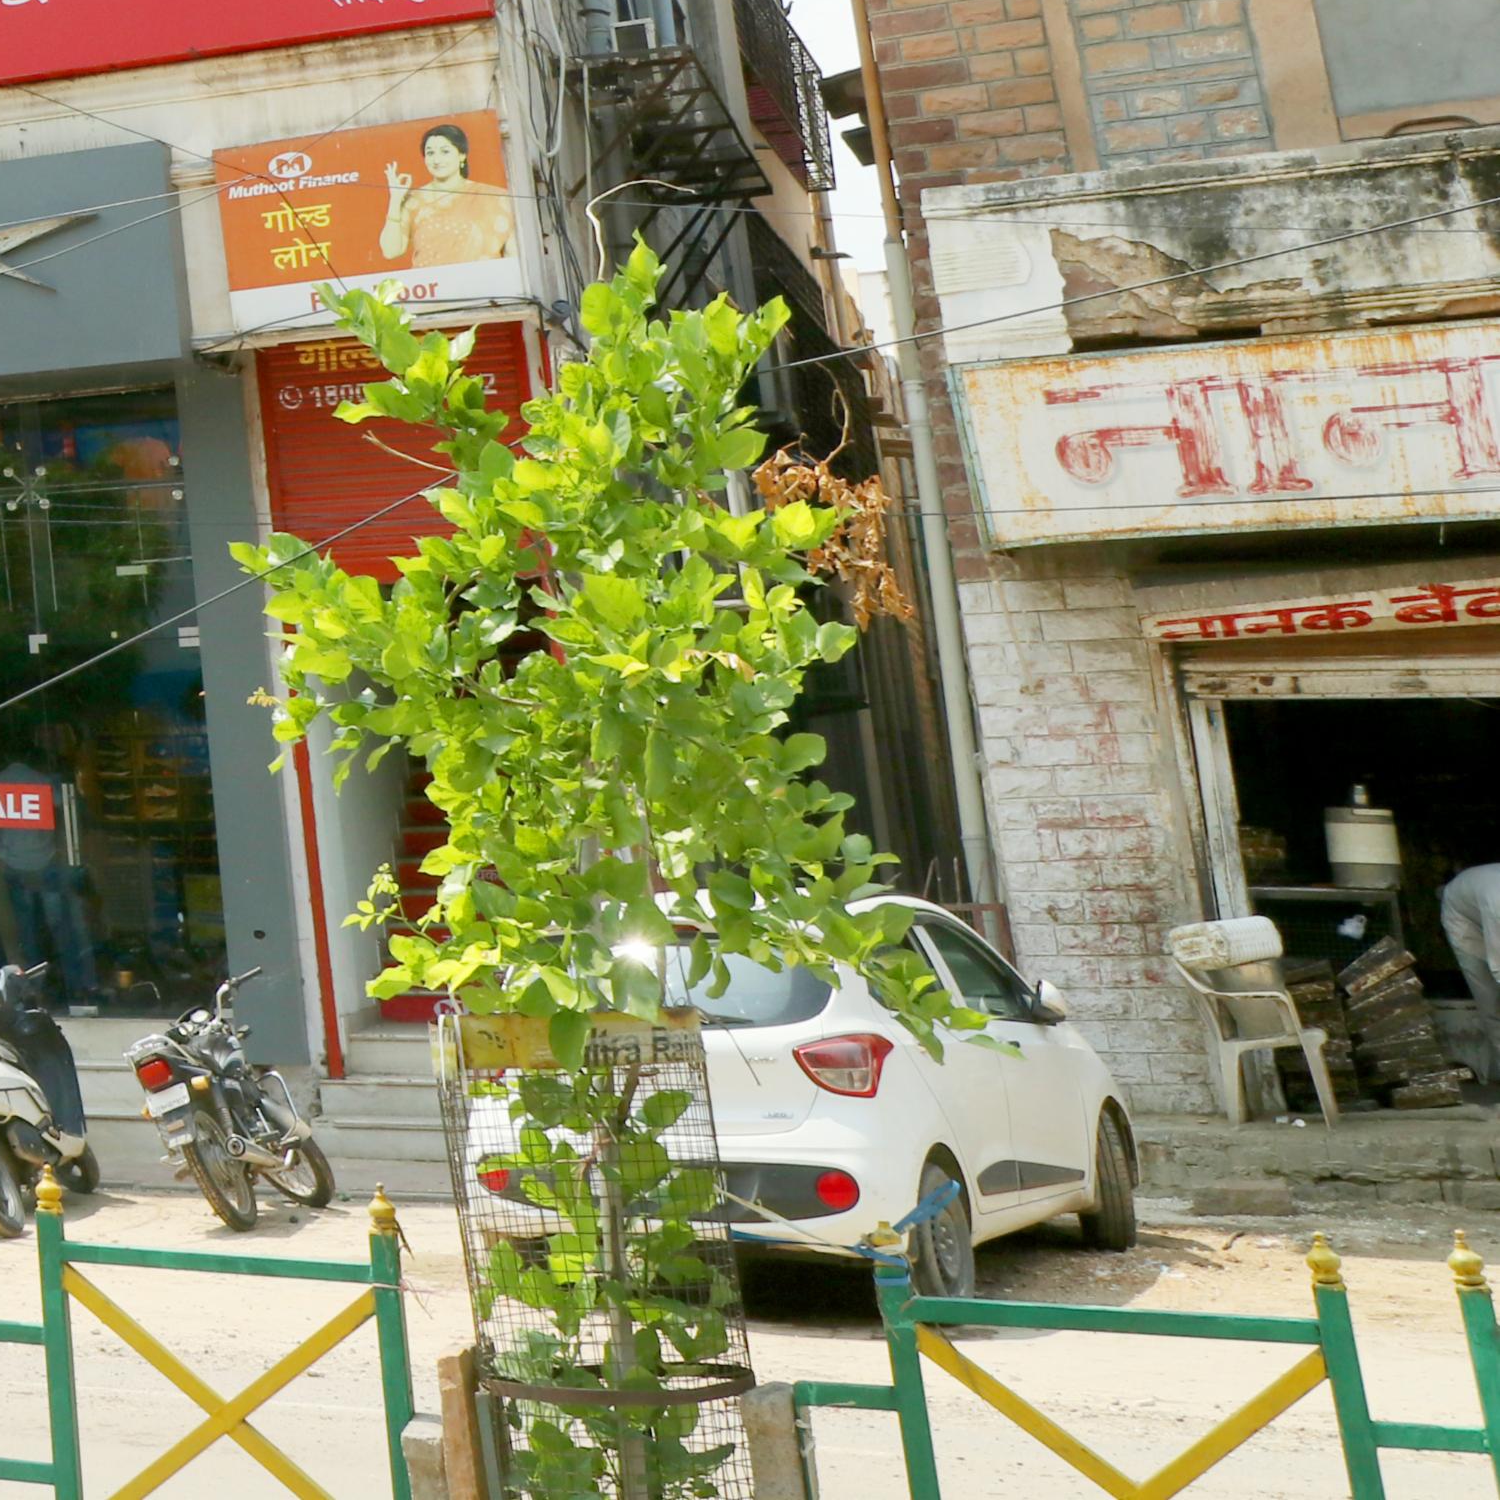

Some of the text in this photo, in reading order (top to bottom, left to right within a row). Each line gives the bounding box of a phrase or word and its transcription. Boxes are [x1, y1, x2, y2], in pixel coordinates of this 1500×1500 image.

[228, 169, 360, 201] Muthoot Finance
[261, 201, 332, 234] गोल्ड
[271, 238, 332, 272] लोन
[1156, 599, 1373, 639] नानक
